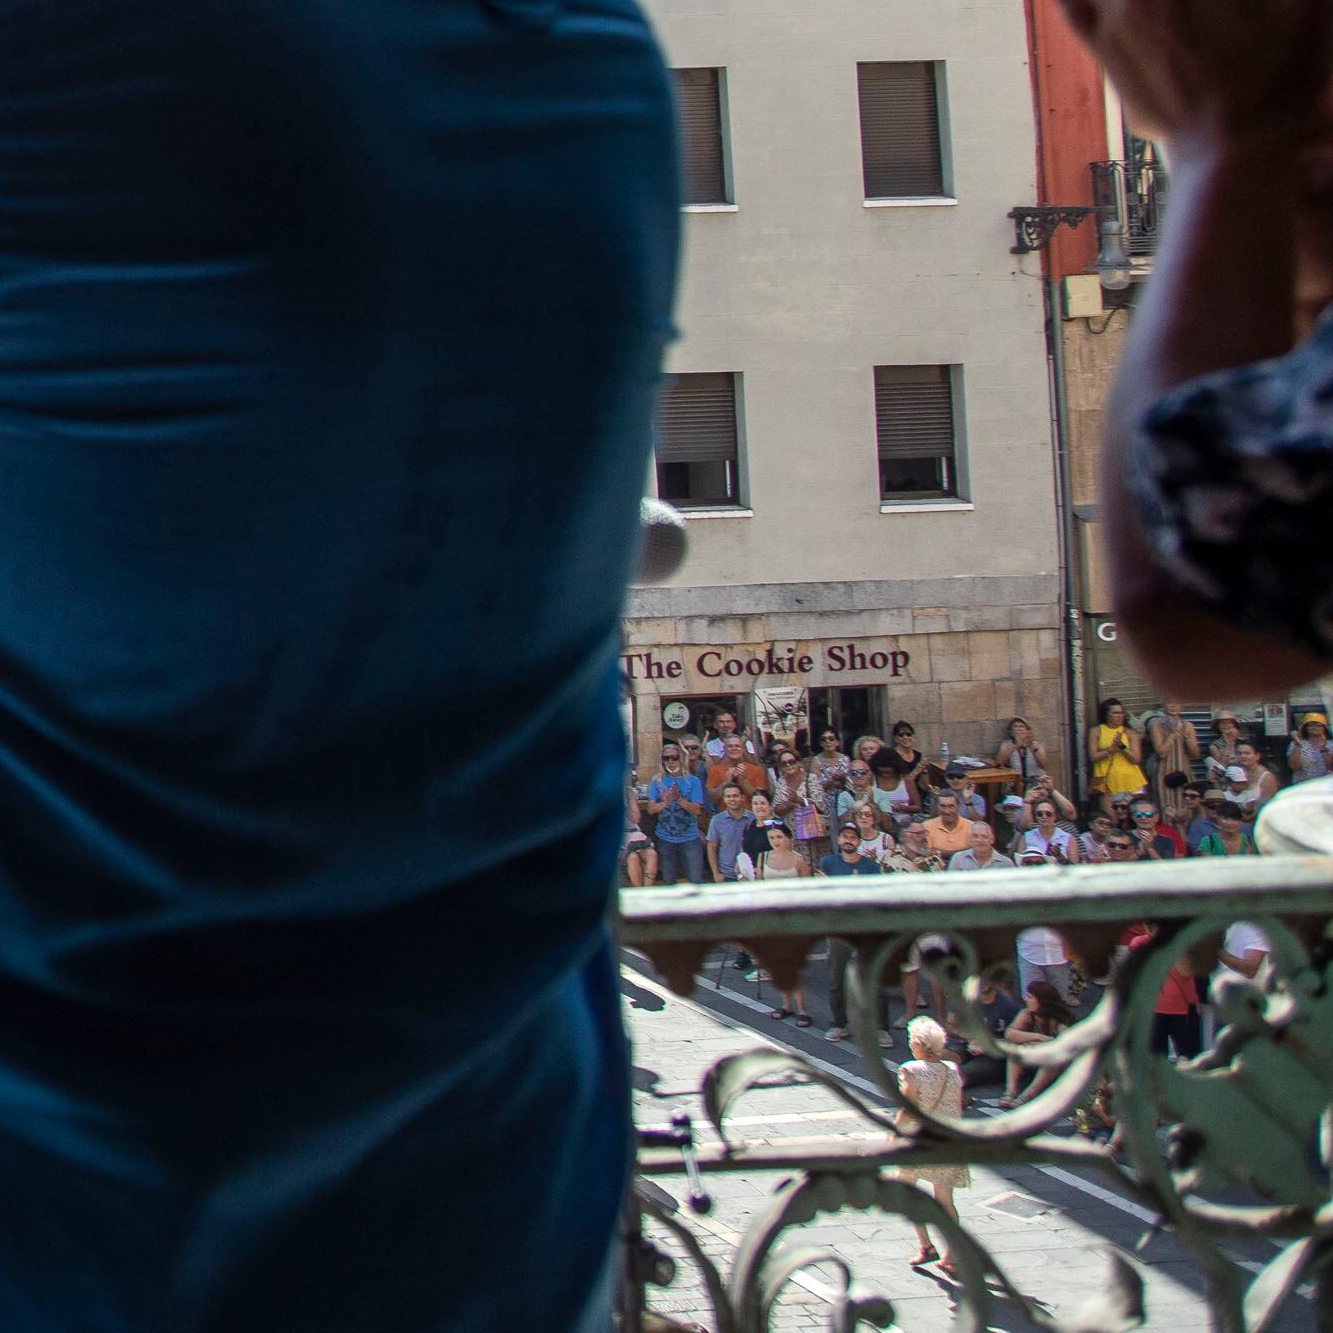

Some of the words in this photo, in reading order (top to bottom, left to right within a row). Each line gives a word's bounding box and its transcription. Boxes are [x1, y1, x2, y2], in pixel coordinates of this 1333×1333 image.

[621, 651, 682, 679] The
[697, 646, 814, 677] Cookie
[827, 643, 911, 677] Shop
